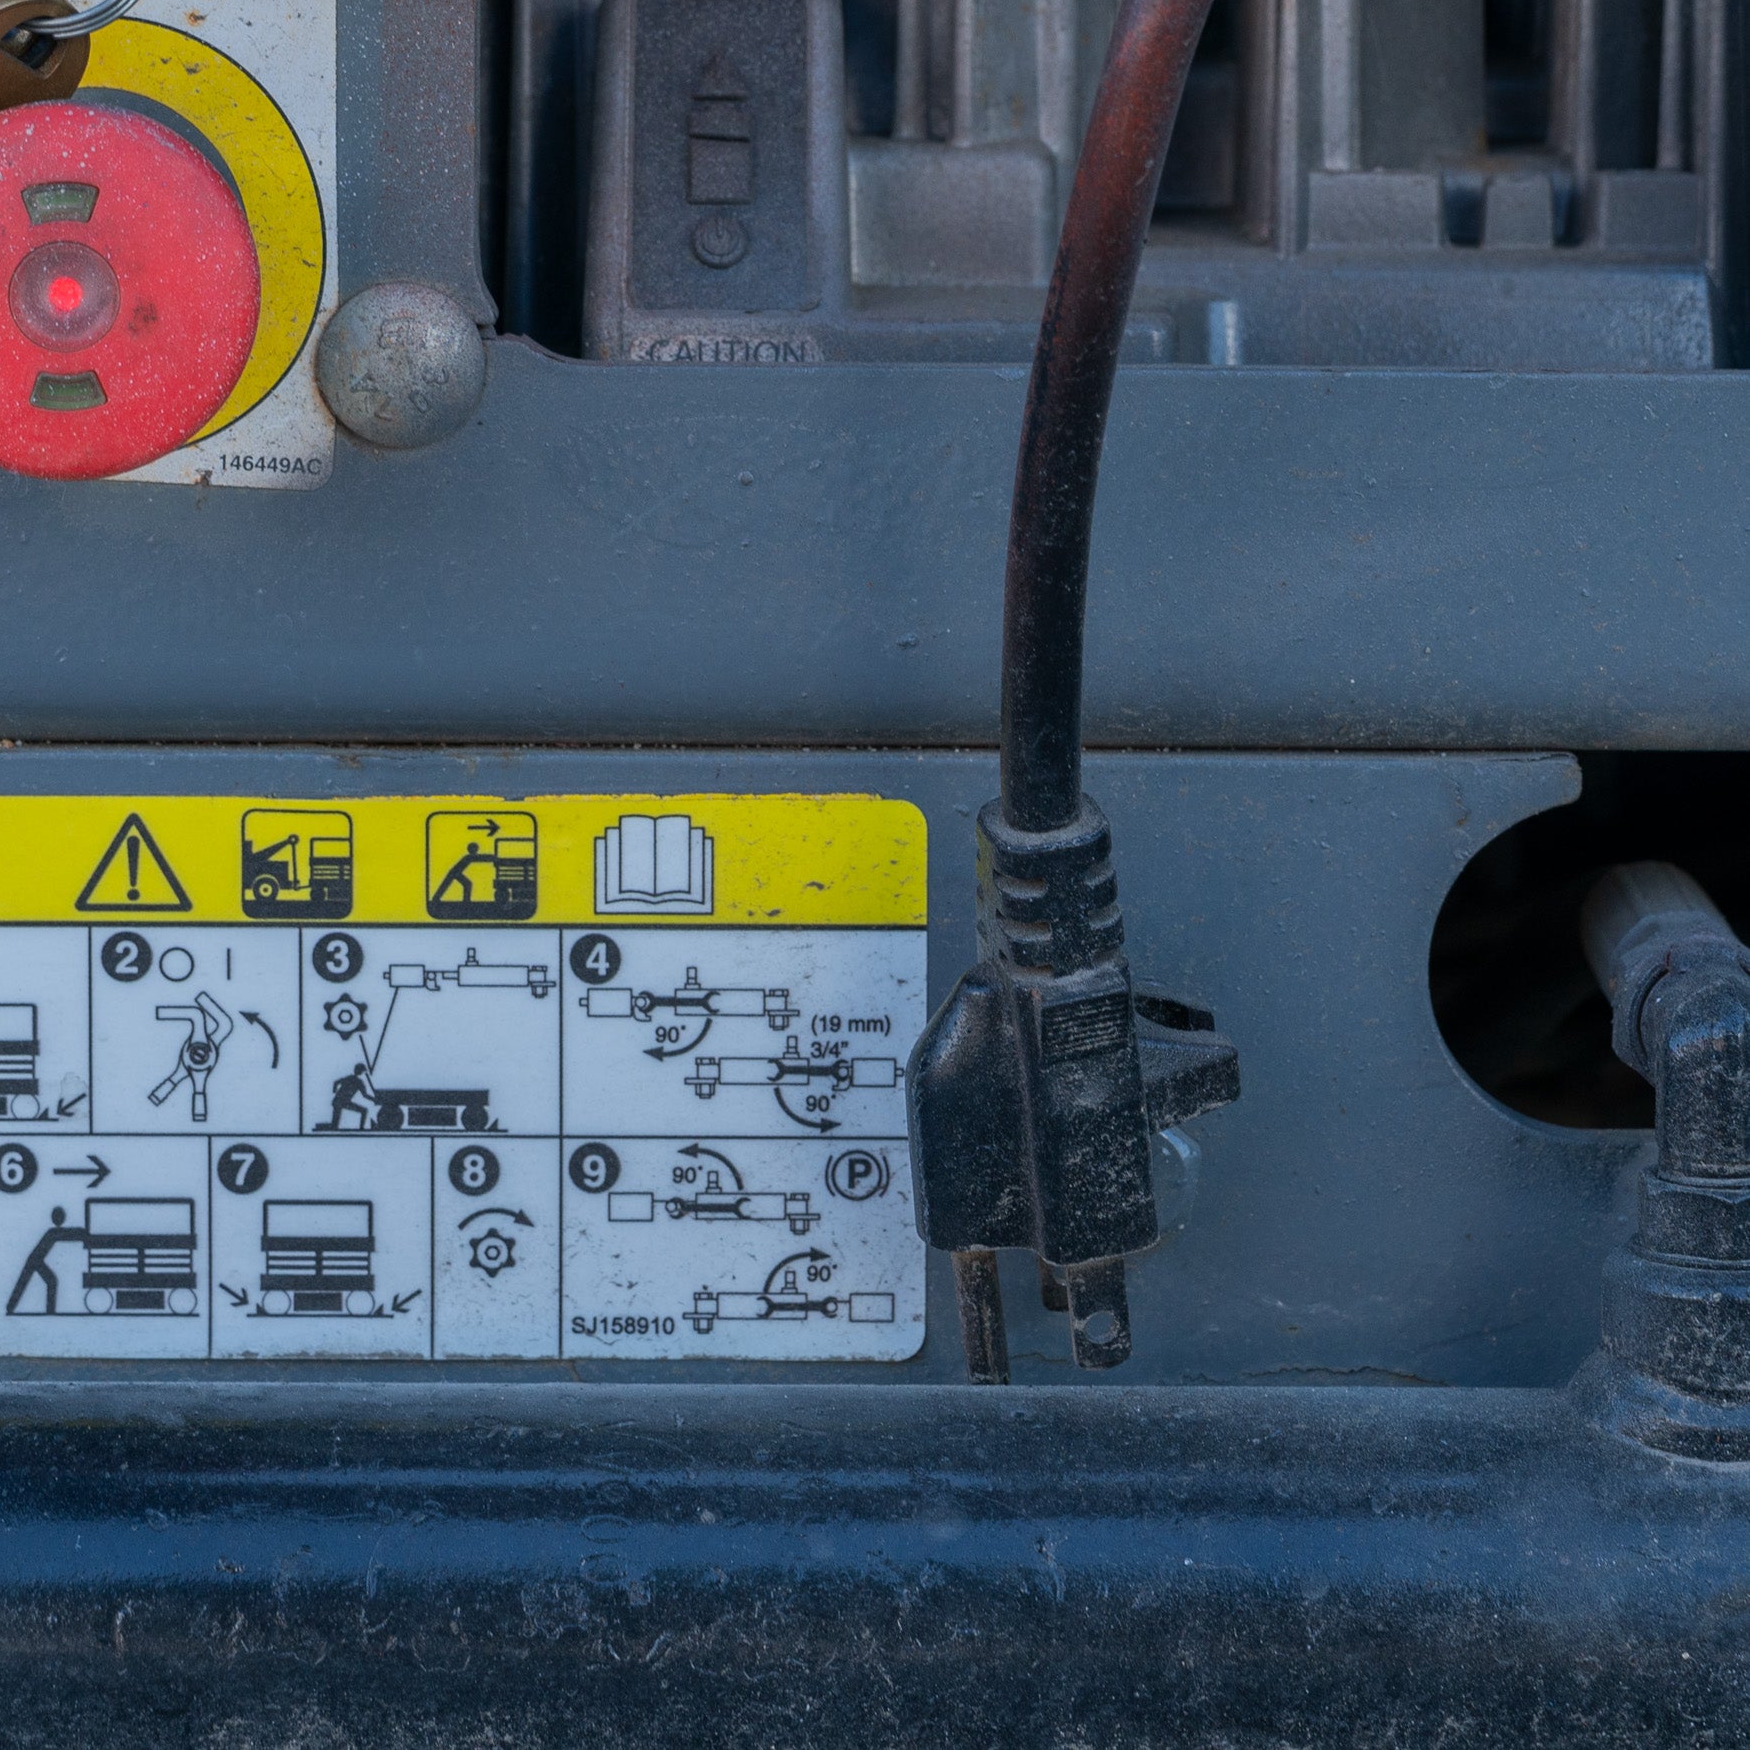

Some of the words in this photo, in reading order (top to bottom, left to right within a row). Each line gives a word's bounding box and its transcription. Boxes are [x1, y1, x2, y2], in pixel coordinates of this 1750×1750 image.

[649, 338, 806, 362] CAUTION
[219, 454, 322, 476] 146449AC
[811, 1014, 840, 1036] (19
[849, 1014, 891, 1036] mm)
[571, 1316, 675, 1336] SJ158910
